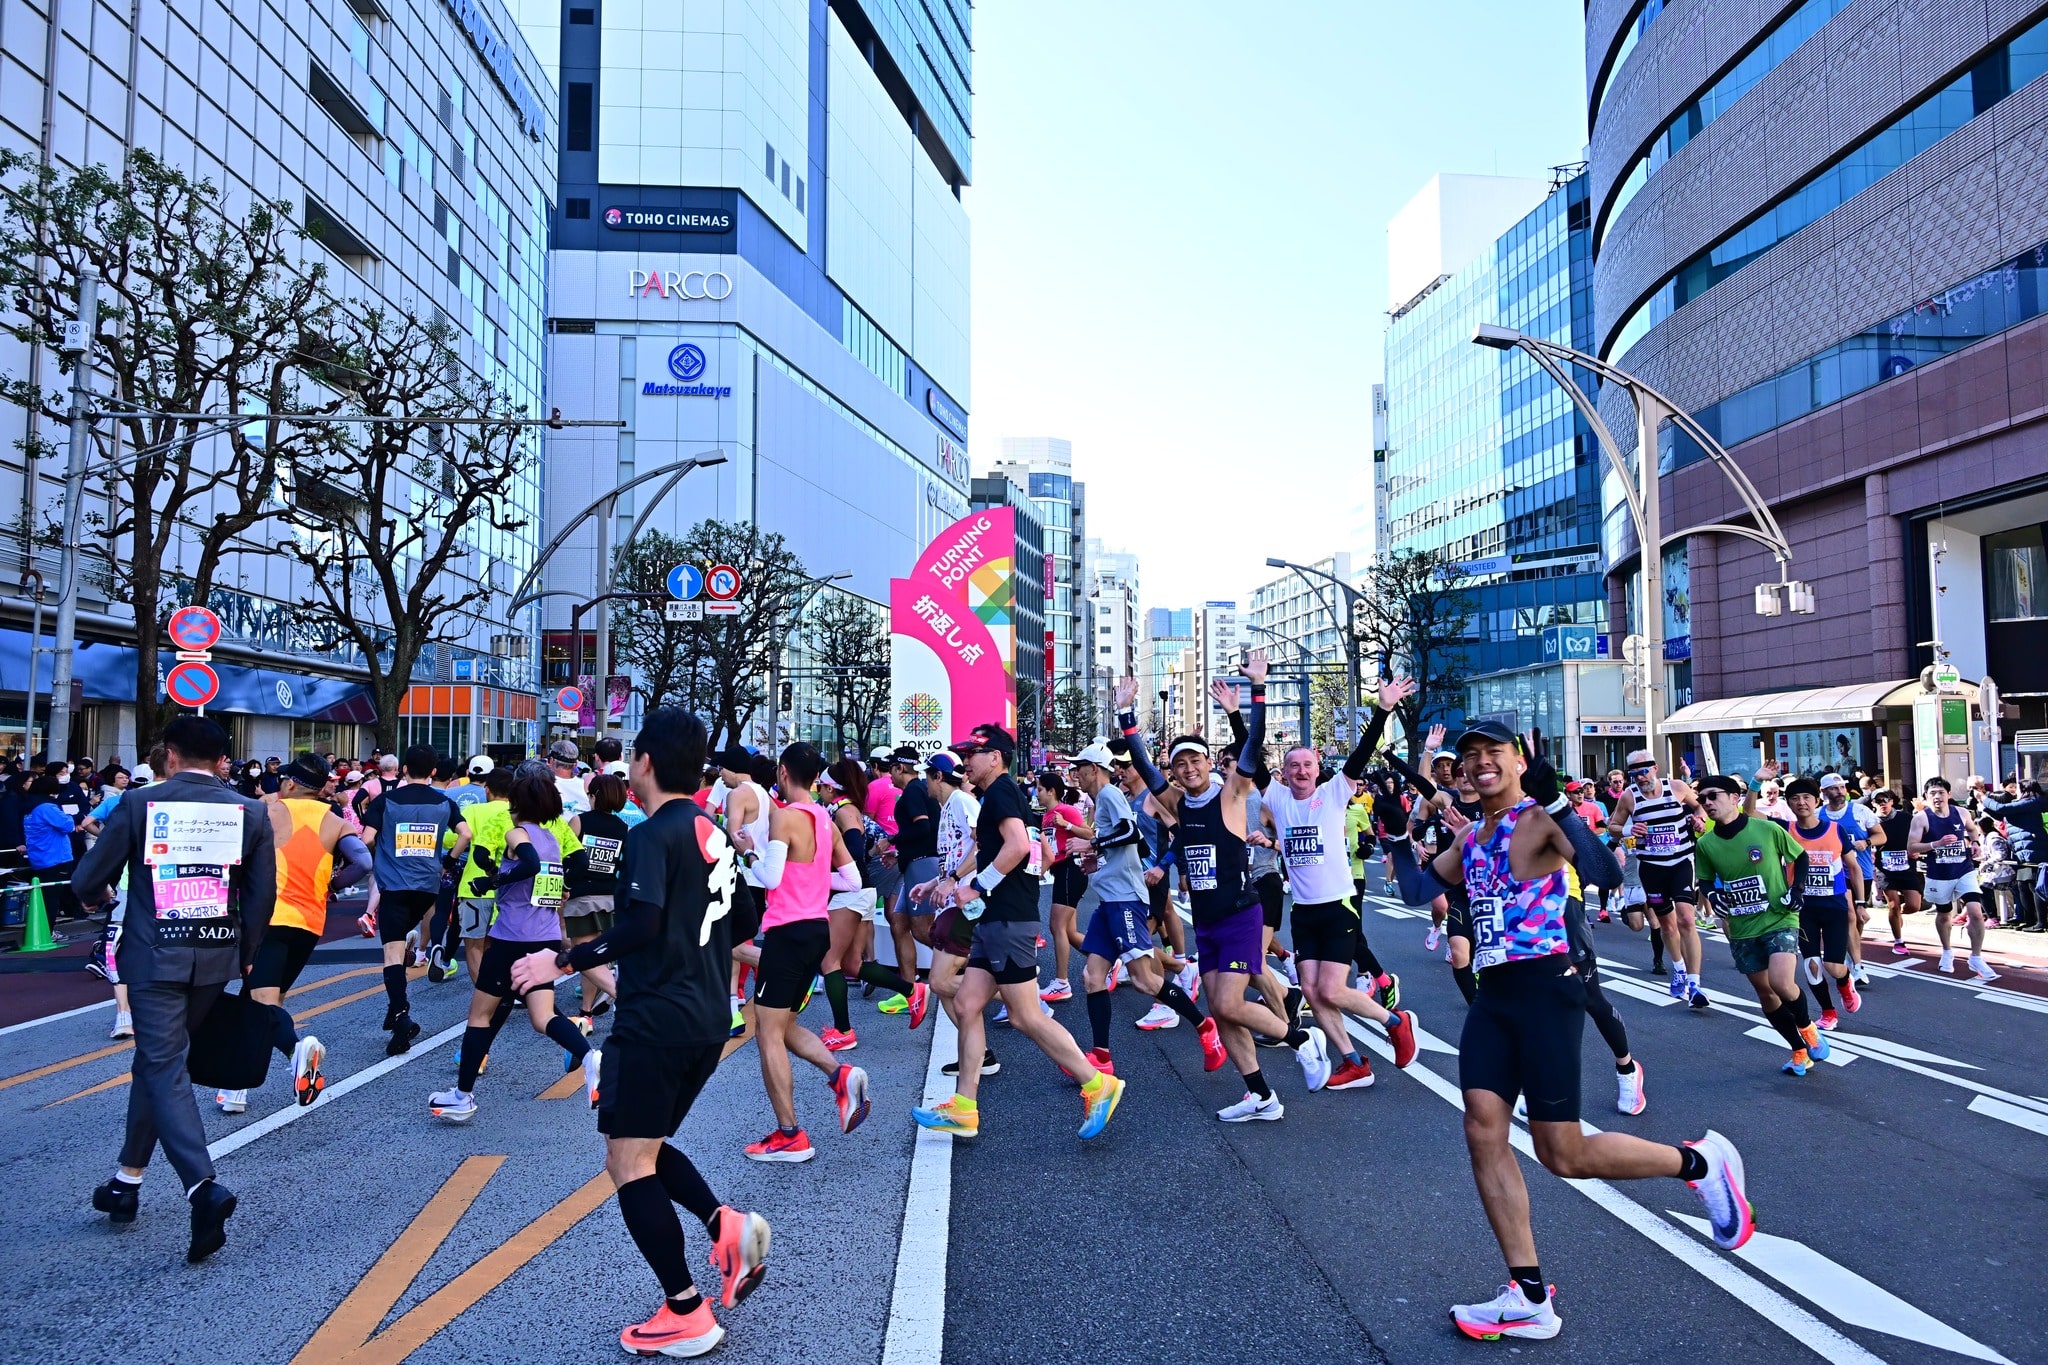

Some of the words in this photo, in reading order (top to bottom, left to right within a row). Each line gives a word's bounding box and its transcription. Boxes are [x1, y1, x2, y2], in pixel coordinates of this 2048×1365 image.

[625, 213, 663, 225] TOHO
[667, 214, 729, 227] CINEMAS
[629, 269, 733, 301] PARCO
[642, 382, 731, 400] Matsuzakaya
[937, 432, 970, 488] PARCO
[929, 517, 992, 578] TURNING
[941, 545, 984, 590] POINT
[1457, 561, 1497, 574] OGISTEED
[911, 594, 985, 666] 折返し点
[1943, 664, 1950, 673] 7
[900, 740, 943, 750] TOKYO
[173, 819, 238, 827] #オーダースーツSADA
[406, 834, 433, 846] 11413
[1651, 834, 1675, 844] 60739
[1290, 839, 1317, 853] 34448
[1941, 848, 1962, 857] 21427
[590, 848, 615, 862] 15038
[179, 866, 221, 875] 東京メトロ
[171, 880, 218, 902] 70025
[198, 926, 235, 939] SADA
[1239, 961, 1248, 970] T8
